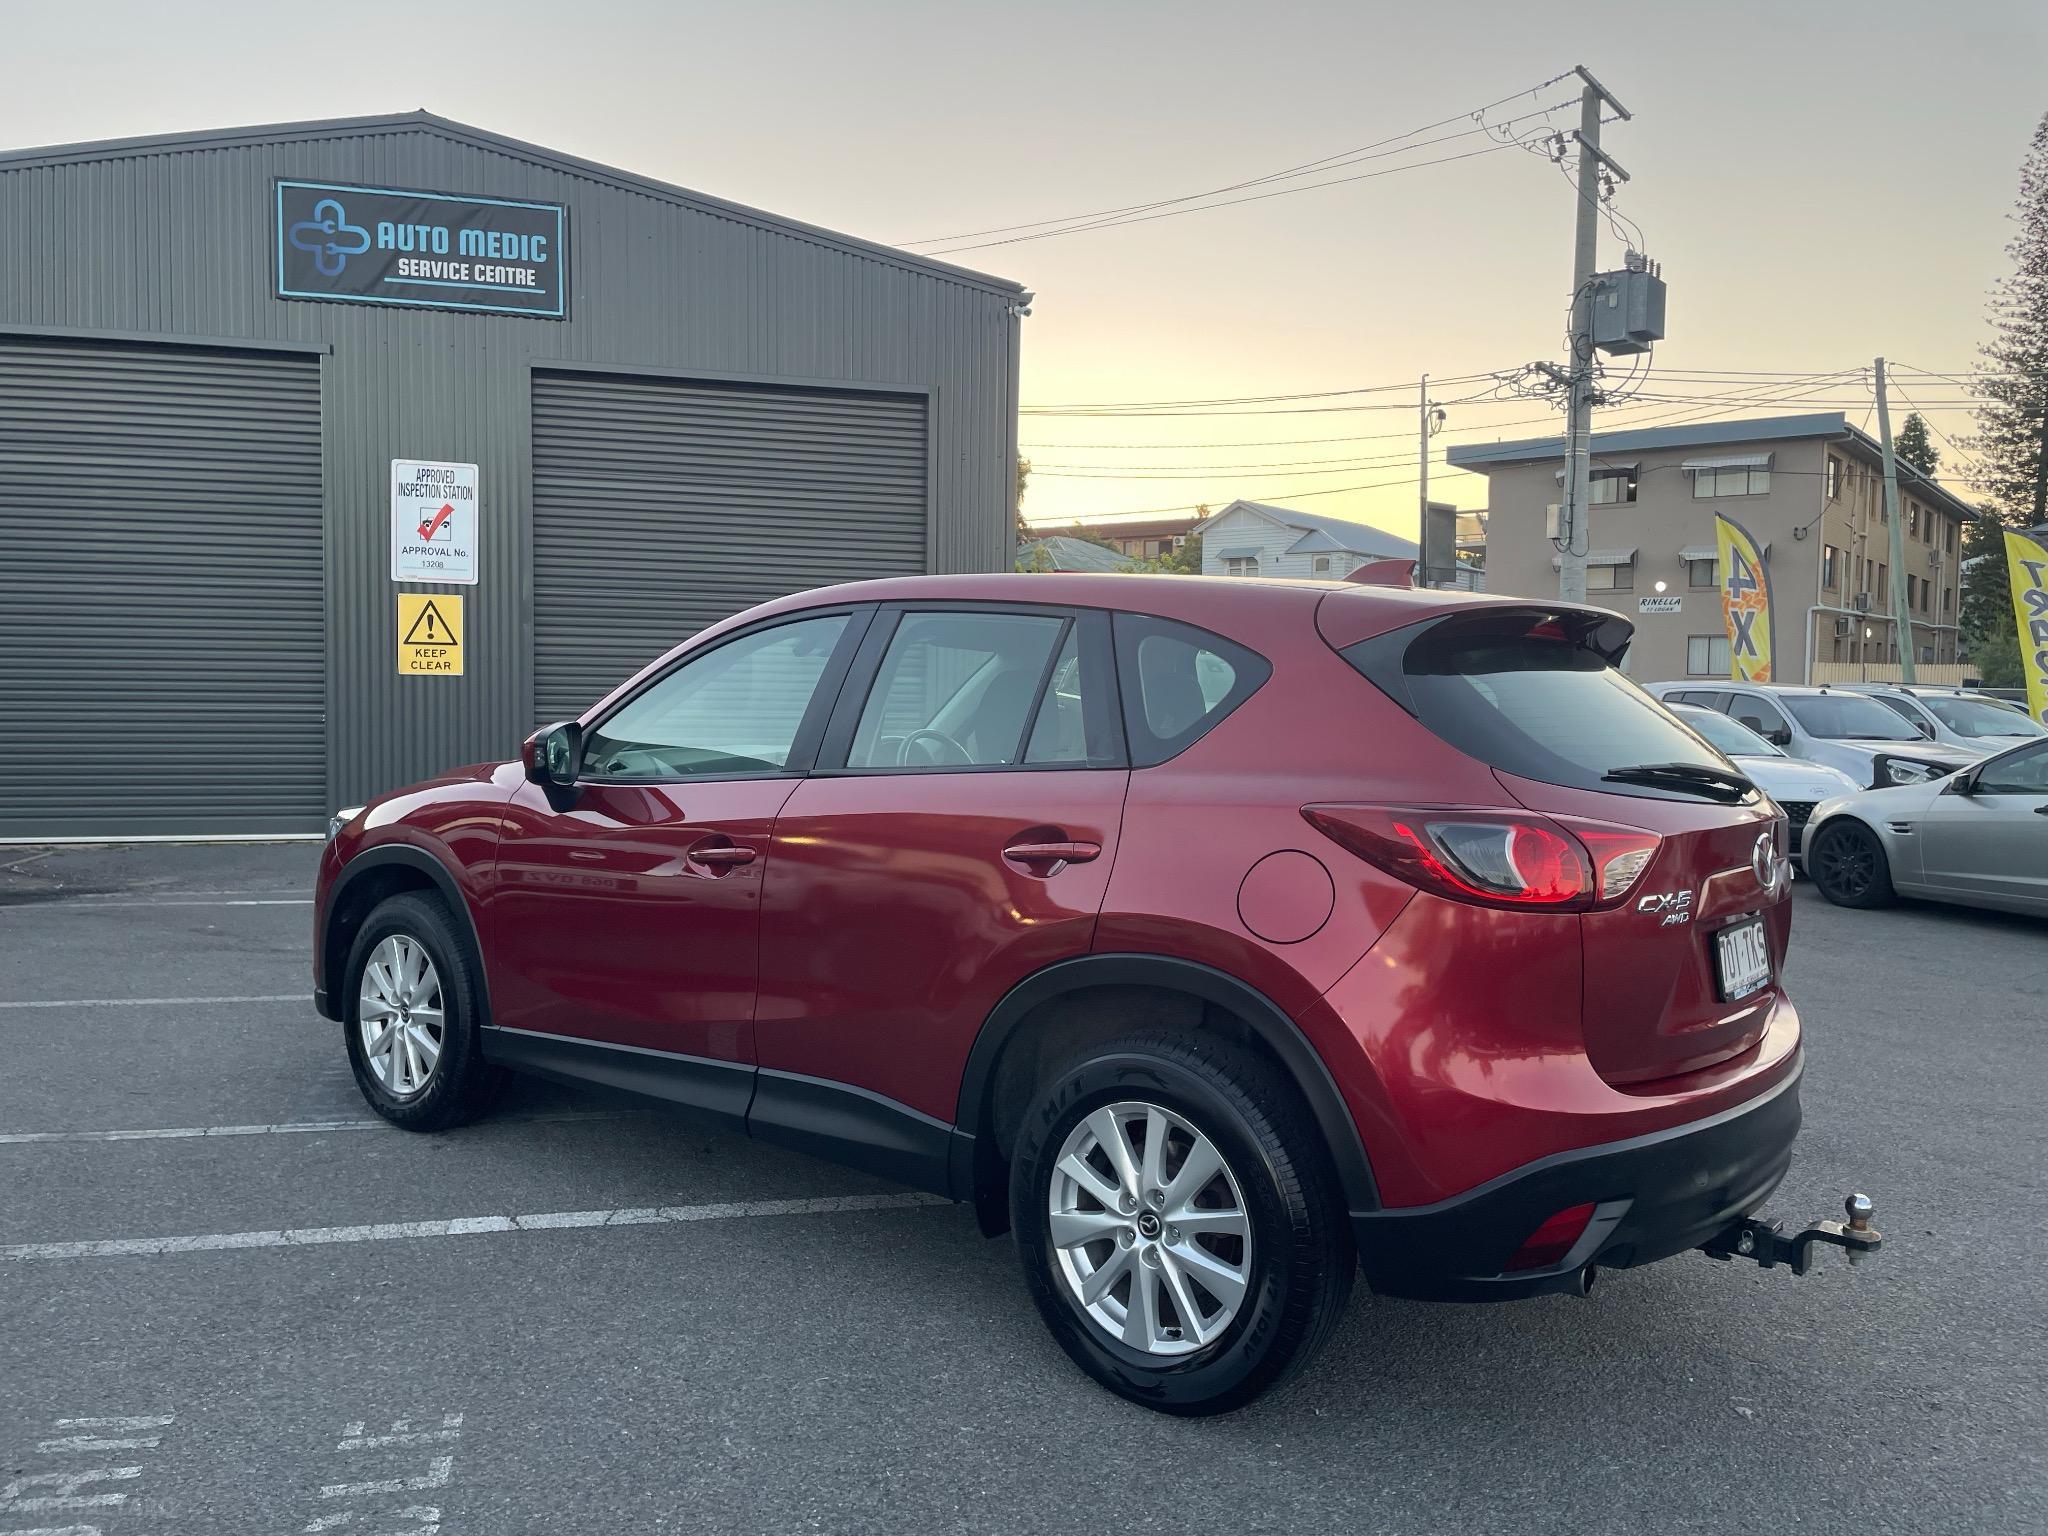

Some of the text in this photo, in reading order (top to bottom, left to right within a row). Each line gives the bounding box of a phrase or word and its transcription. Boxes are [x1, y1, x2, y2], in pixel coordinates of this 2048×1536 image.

[377, 222, 547, 262] AUTO MEDIC
[398, 258, 536, 286] SERVICE CENTRE
[416, 468, 455, 484] APPROVED
[398, 482, 473, 500] INSPECTION STATION
[402, 546, 469, 557] APPROVAL No.
[422, 560, 444, 569] 13208
[1640, 598, 1681, 606] RINELLA
[415, 648, 447, 658] KEEP
[410, 660, 451, 670] CLEAR
[1637, 890, 1692, 913] CX-5
[1661, 912, 1689, 927] AWD
